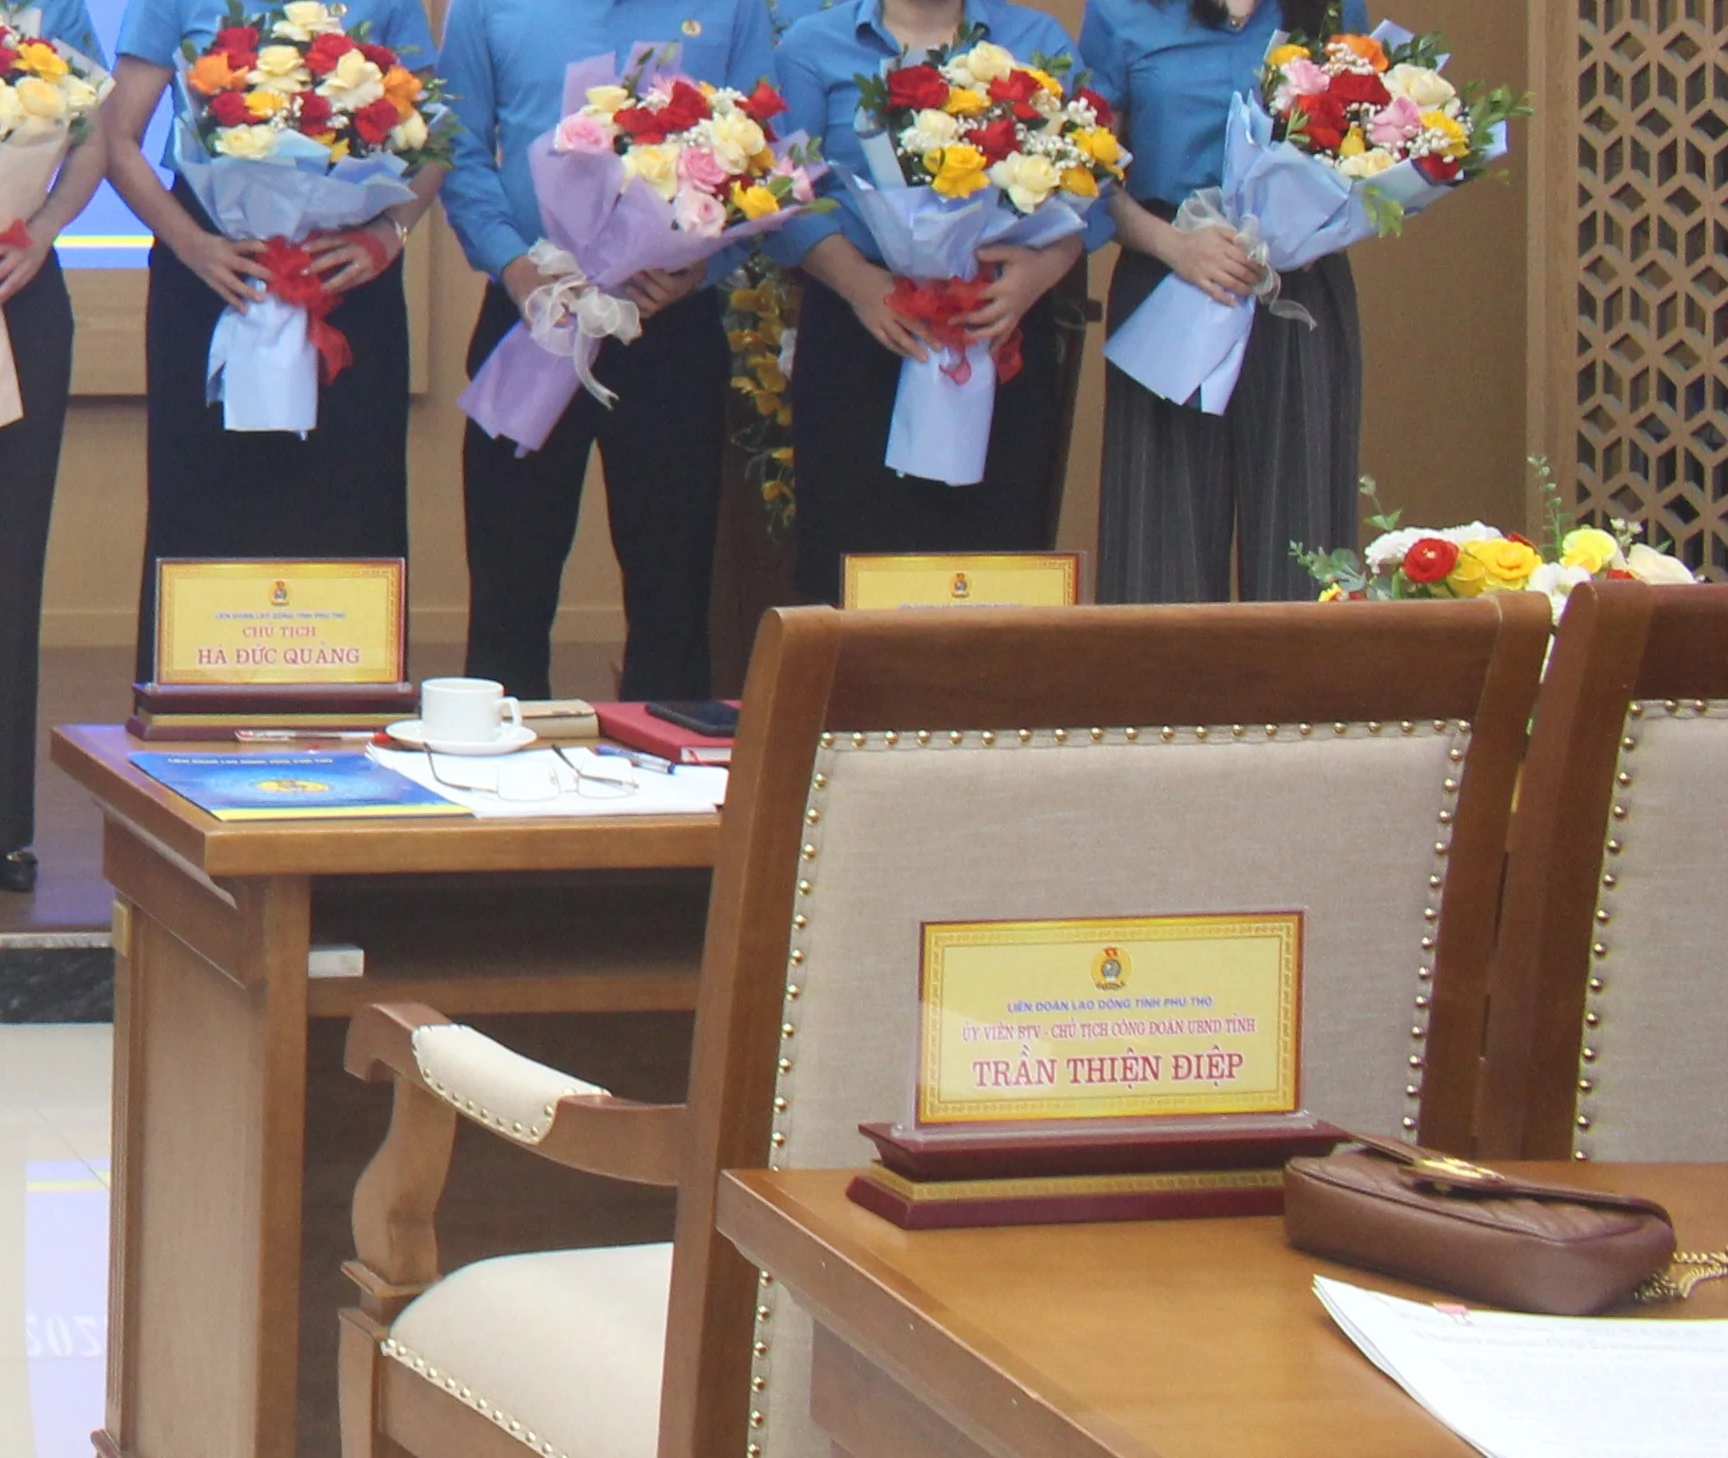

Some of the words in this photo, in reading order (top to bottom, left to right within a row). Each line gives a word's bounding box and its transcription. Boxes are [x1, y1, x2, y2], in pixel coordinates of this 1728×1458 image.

[236, 642, 277, 664] ĐỨC
[972, 1044, 1058, 1087] TRẦN
[1066, 1046, 1162, 1089] THIỆN
[1172, 1044, 1244, 1087] ĐIỆP
